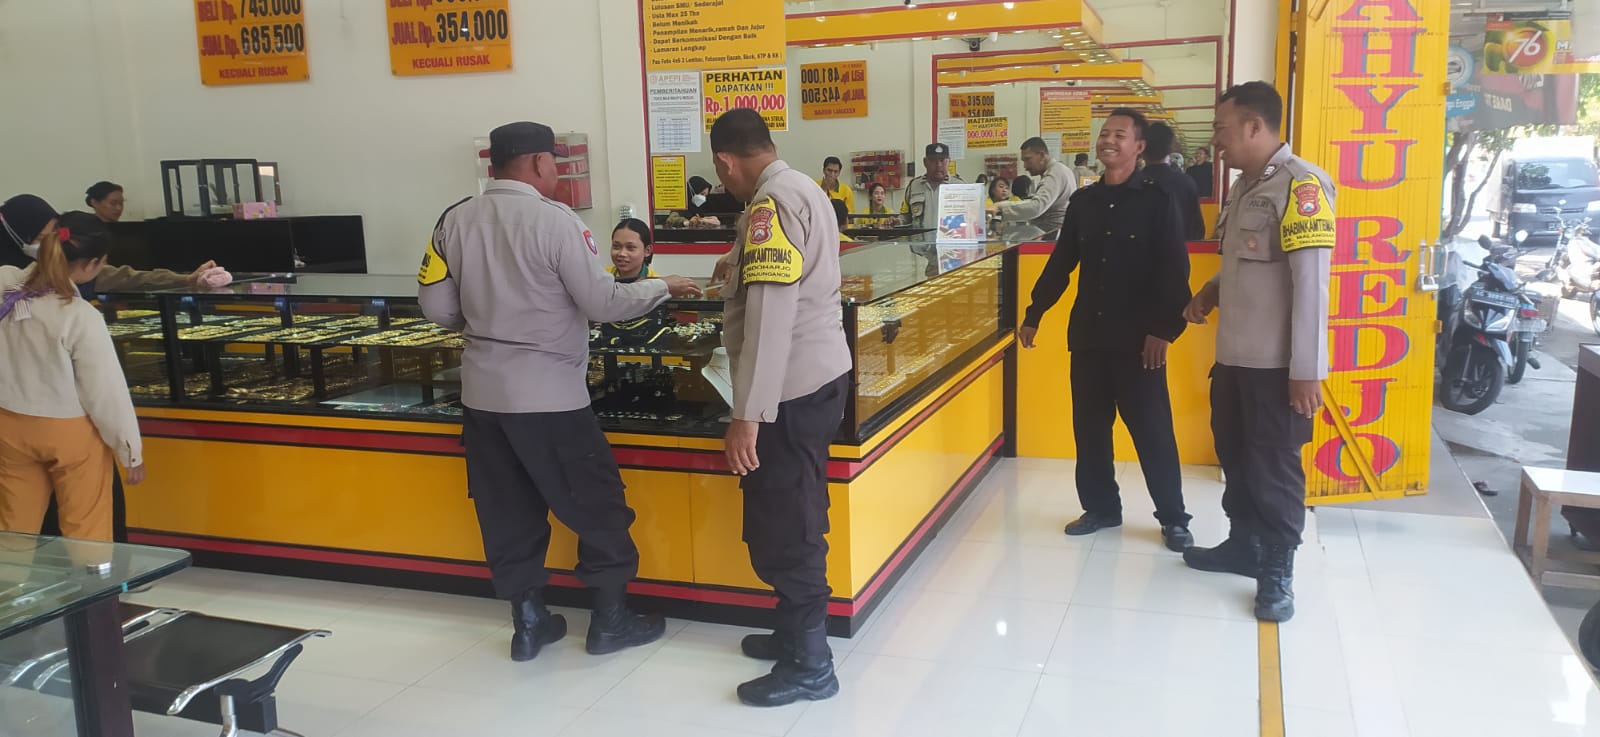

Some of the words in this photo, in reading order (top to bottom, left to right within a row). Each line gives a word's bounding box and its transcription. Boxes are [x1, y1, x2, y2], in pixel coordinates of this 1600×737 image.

[201, 35, 223, 56] JUAL
[241, 23, 304, 55] 685.500
[392, 22, 417, 45] JUAL
[418, 21, 435, 48] Rp.
[436, 9, 508, 43] 354.000
[1508, 30, 1543, 63] 76
[219, 68, 256, 79] KECUALI
[258, 66, 288, 77] RUSAK
[413, 56, 453, 69] KECUALI
[456, 54, 490, 66] RUSAK
[706, 70, 783, 83] PERHATIAN
[715, 83, 763, 93] DAPATKAN
[705, 94, 785, 116] Rp.1000,000
[1314, 215, 1412, 482] REDJO
